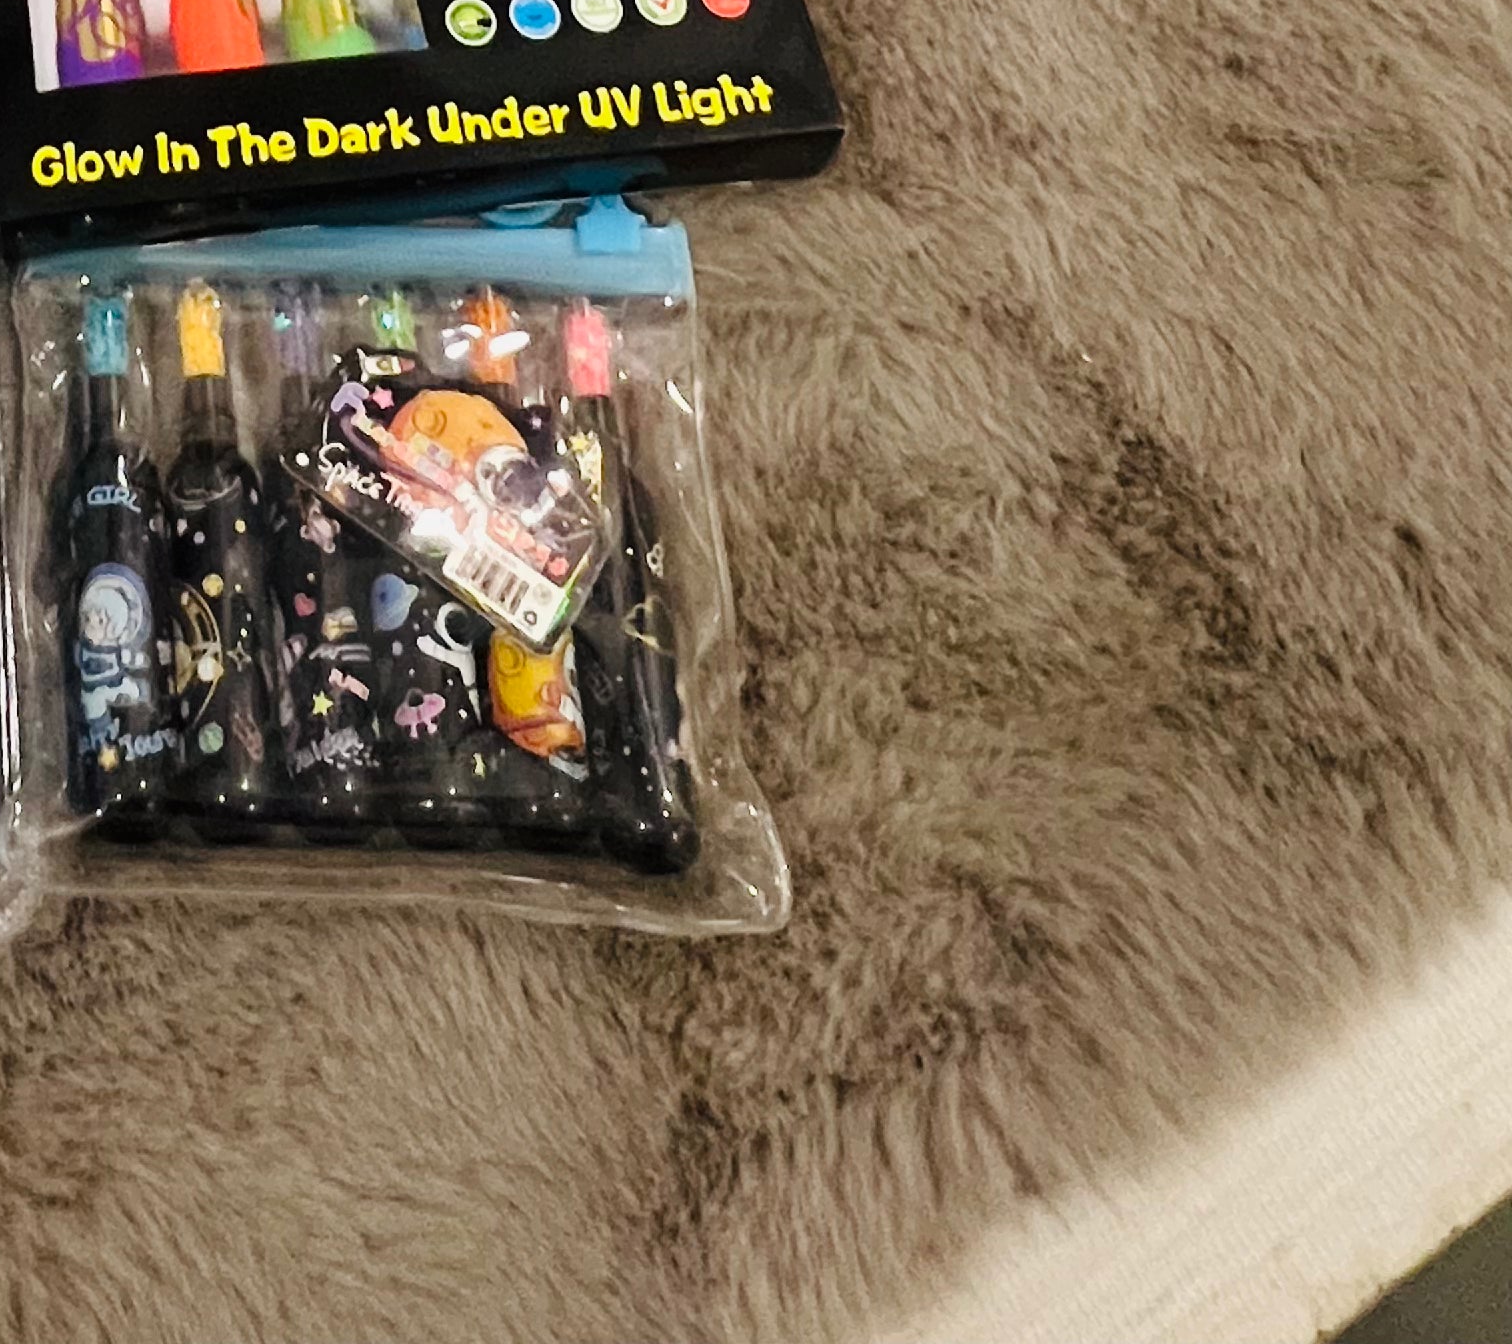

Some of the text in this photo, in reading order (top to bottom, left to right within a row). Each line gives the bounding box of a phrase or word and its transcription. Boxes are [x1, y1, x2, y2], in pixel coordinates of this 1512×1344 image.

[31, 73, 774, 188] Glow In The Dark Under UV Light
